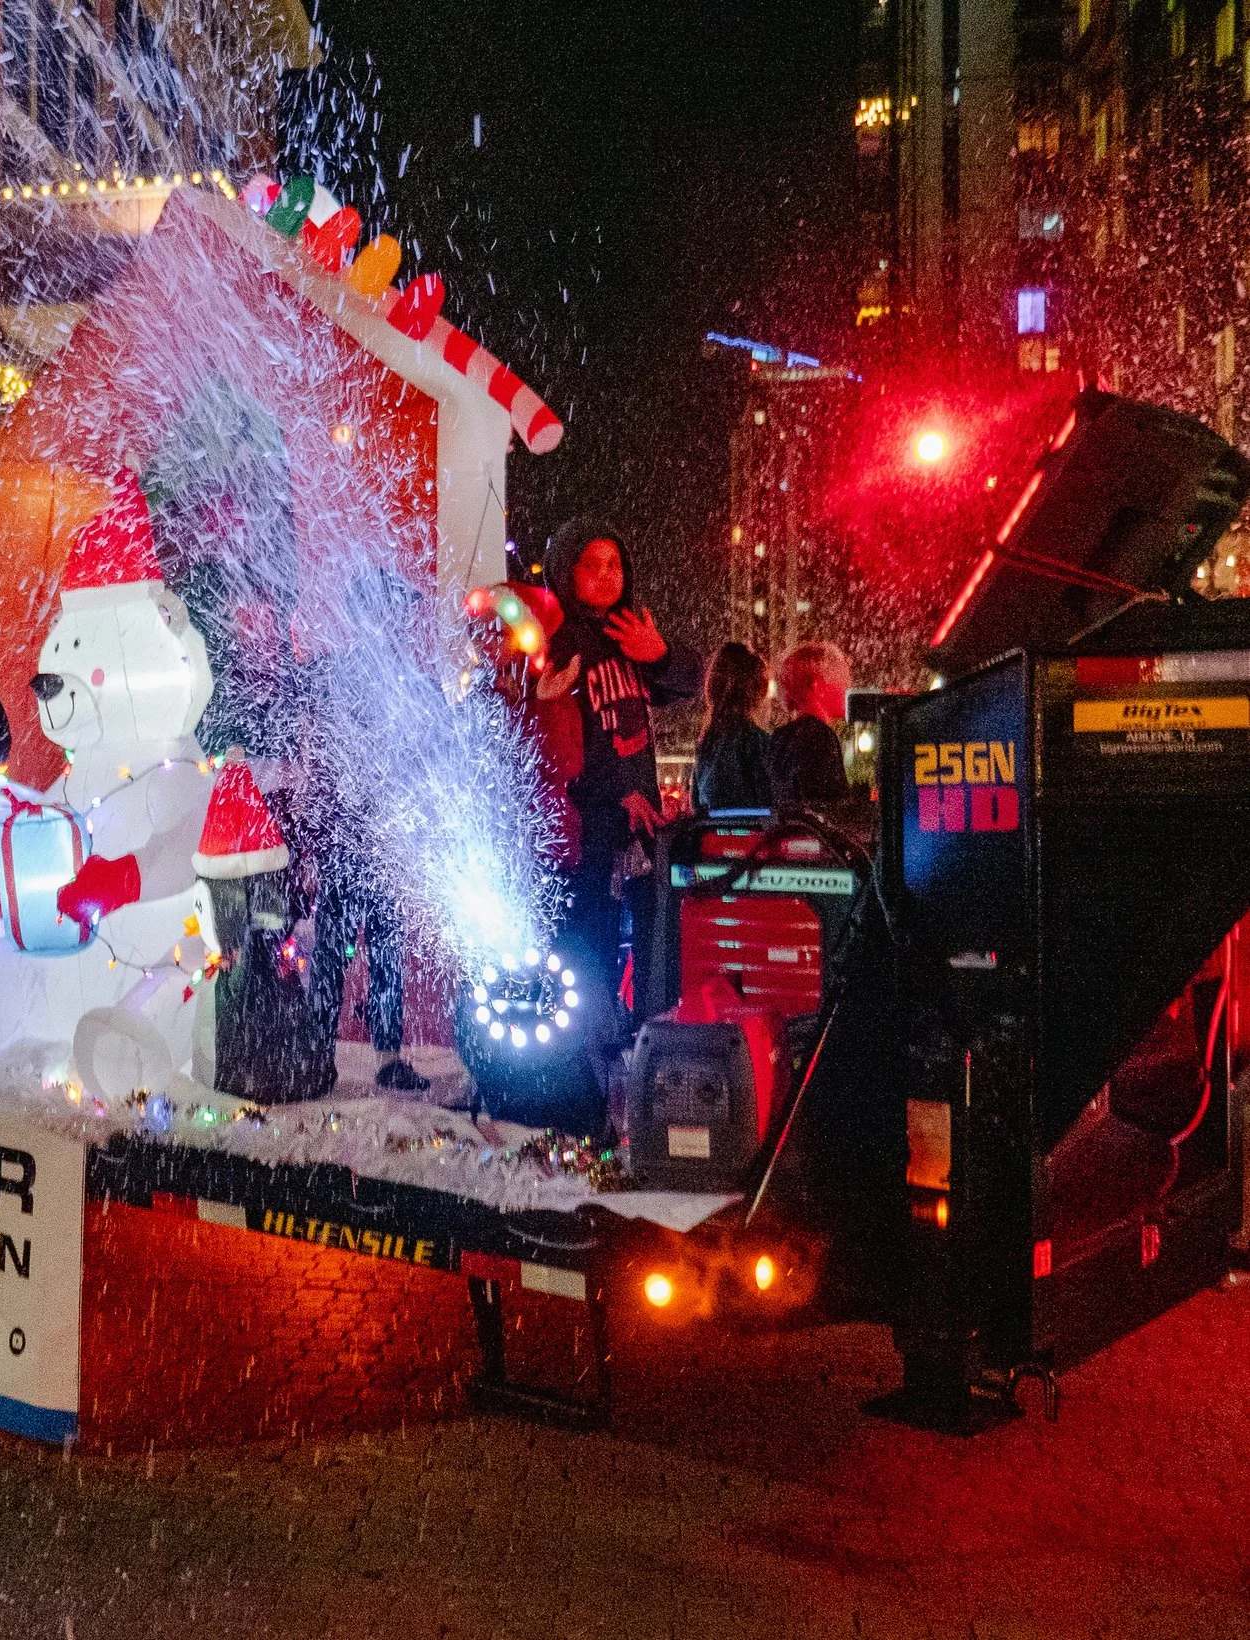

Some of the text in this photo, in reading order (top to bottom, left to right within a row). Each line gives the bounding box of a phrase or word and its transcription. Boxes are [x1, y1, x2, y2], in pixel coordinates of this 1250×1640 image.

[914, 741, 1015, 785] 25GN
[918, 786, 1019, 832] HD
[263, 1208, 436, 1266] HI-TENSILE
